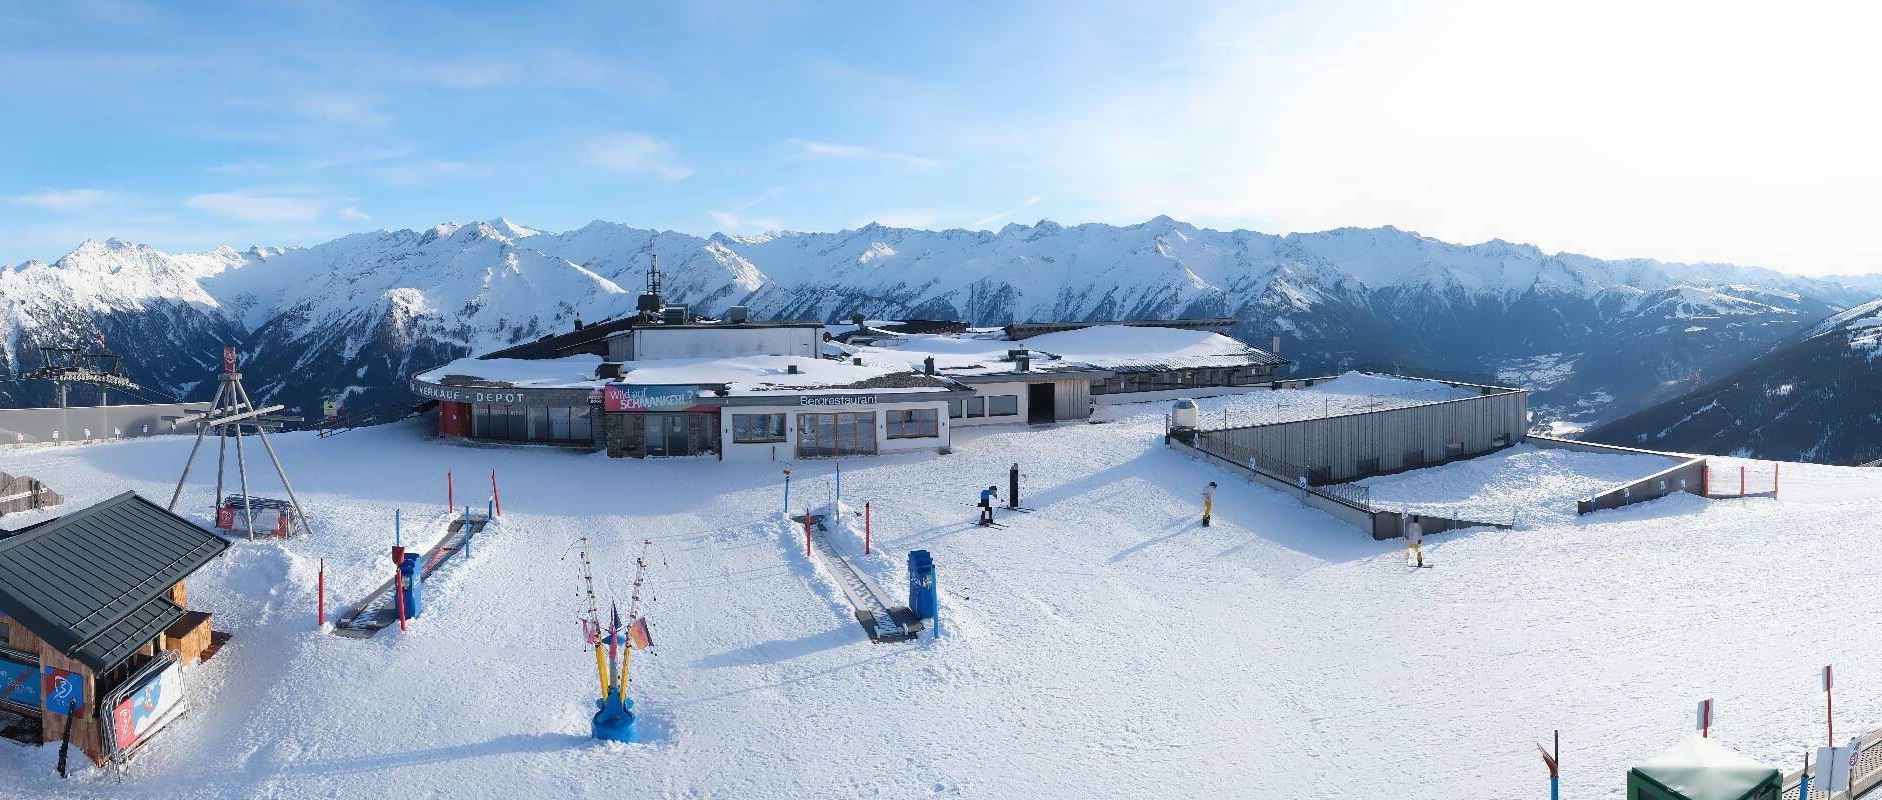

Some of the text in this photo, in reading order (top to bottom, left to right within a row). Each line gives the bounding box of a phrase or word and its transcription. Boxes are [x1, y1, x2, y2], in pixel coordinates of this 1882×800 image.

[419, 386, 460, 400] VERKAUF
[476, 392, 524, 402] DEPOT
[610, 388, 647, 400] Wild auf
[800, 395, 877, 407] Bergrestaurant
